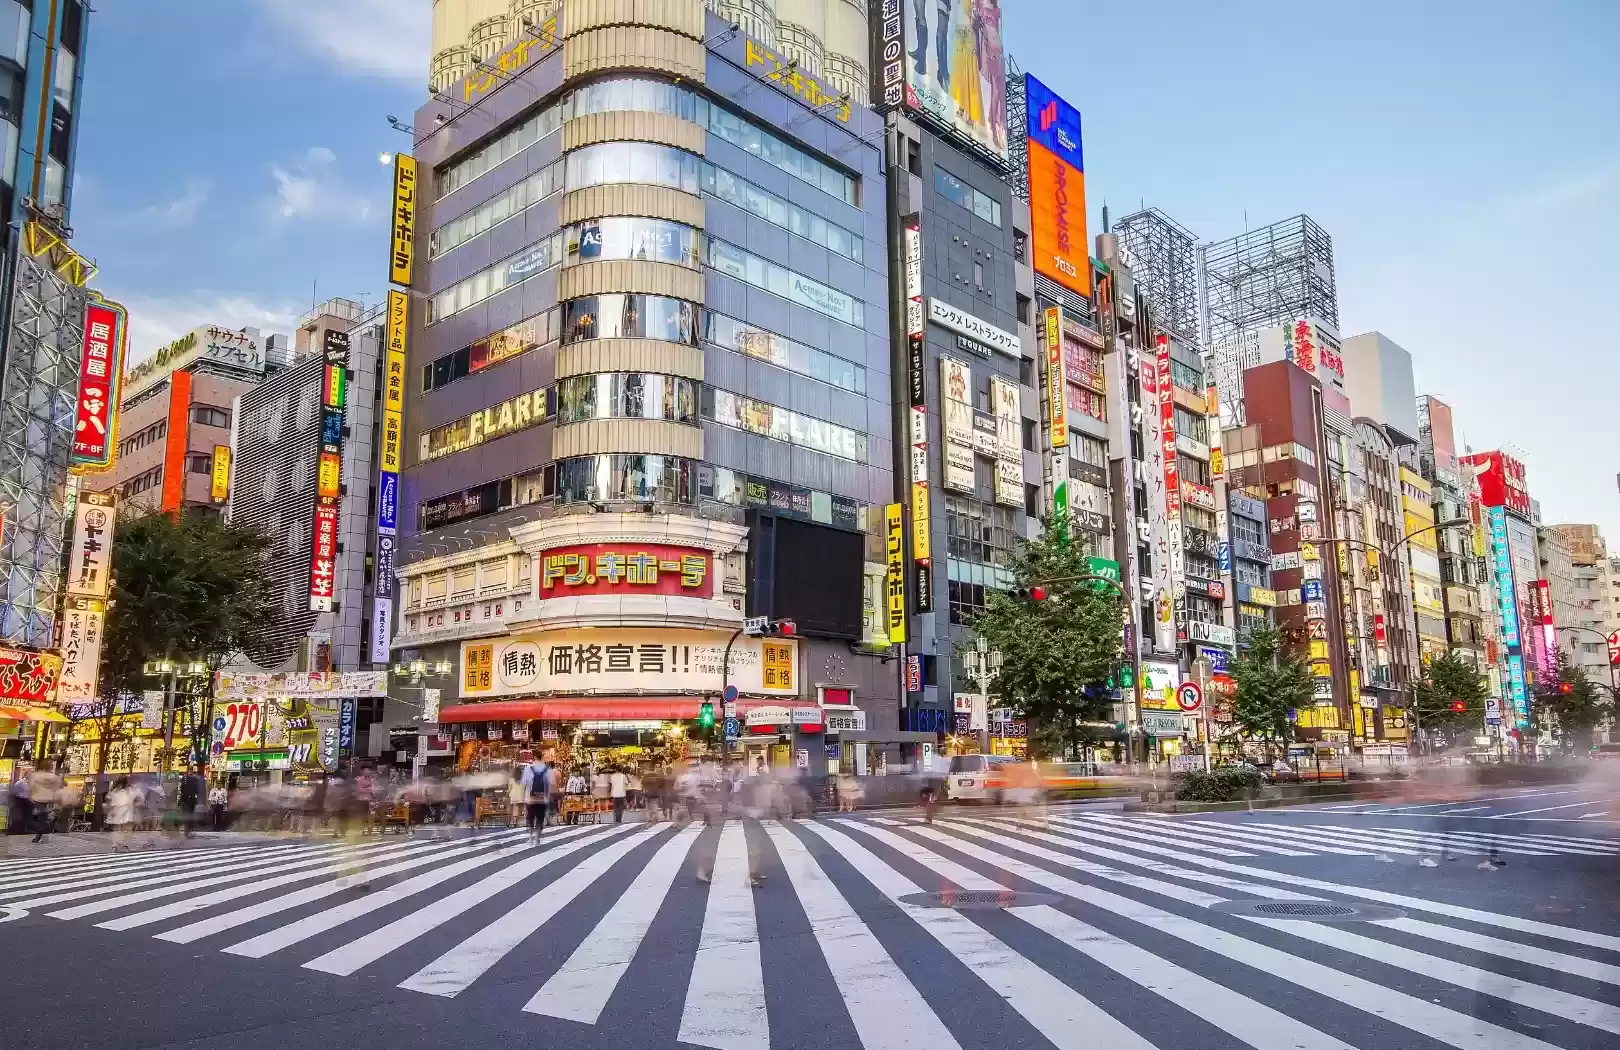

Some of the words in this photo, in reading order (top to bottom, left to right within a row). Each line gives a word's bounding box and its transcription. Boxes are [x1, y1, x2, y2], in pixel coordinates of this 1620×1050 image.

[1054, 160, 1070, 257] PROMISE
[1053, 255, 1077, 279] プロミス
[207, 326, 249, 346] サウナ
[962, 339, 992, 357] SQUARE
[87, 321, 110, 377] 居酒屋
[206, 342, 264, 366] カプセル
[388, 362, 401, 402] 貴金属
[470, 388, 547, 438] FLARE
[385, 418, 398, 466] 高額買取
[773, 409, 855, 452] FLARE
[88, 494, 109, 506] 6F
[322, 497, 334, 505] 6F
[747, 482, 768, 500] 販売
[318, 520, 333, 556] 居楽屋
[1221, 542, 1230, 570] 747
[312, 560, 334, 595] 笑笑
[76, 600, 97, 611] 5F
[467, 649, 490, 665] 情熱
[502, 650, 536, 677] 情熱
[549, 643, 689, 675] 価格宣言!!
[765, 647, 789, 664] 情熱
[467, 671, 490, 687] 価格
[765, 669, 789, 685] 価格
[340, 701, 353, 747] カラオケ
[288, 743, 312, 765] 747
[324, 727, 336, 767] カラオケ
[924, 745, 930, 757] P
